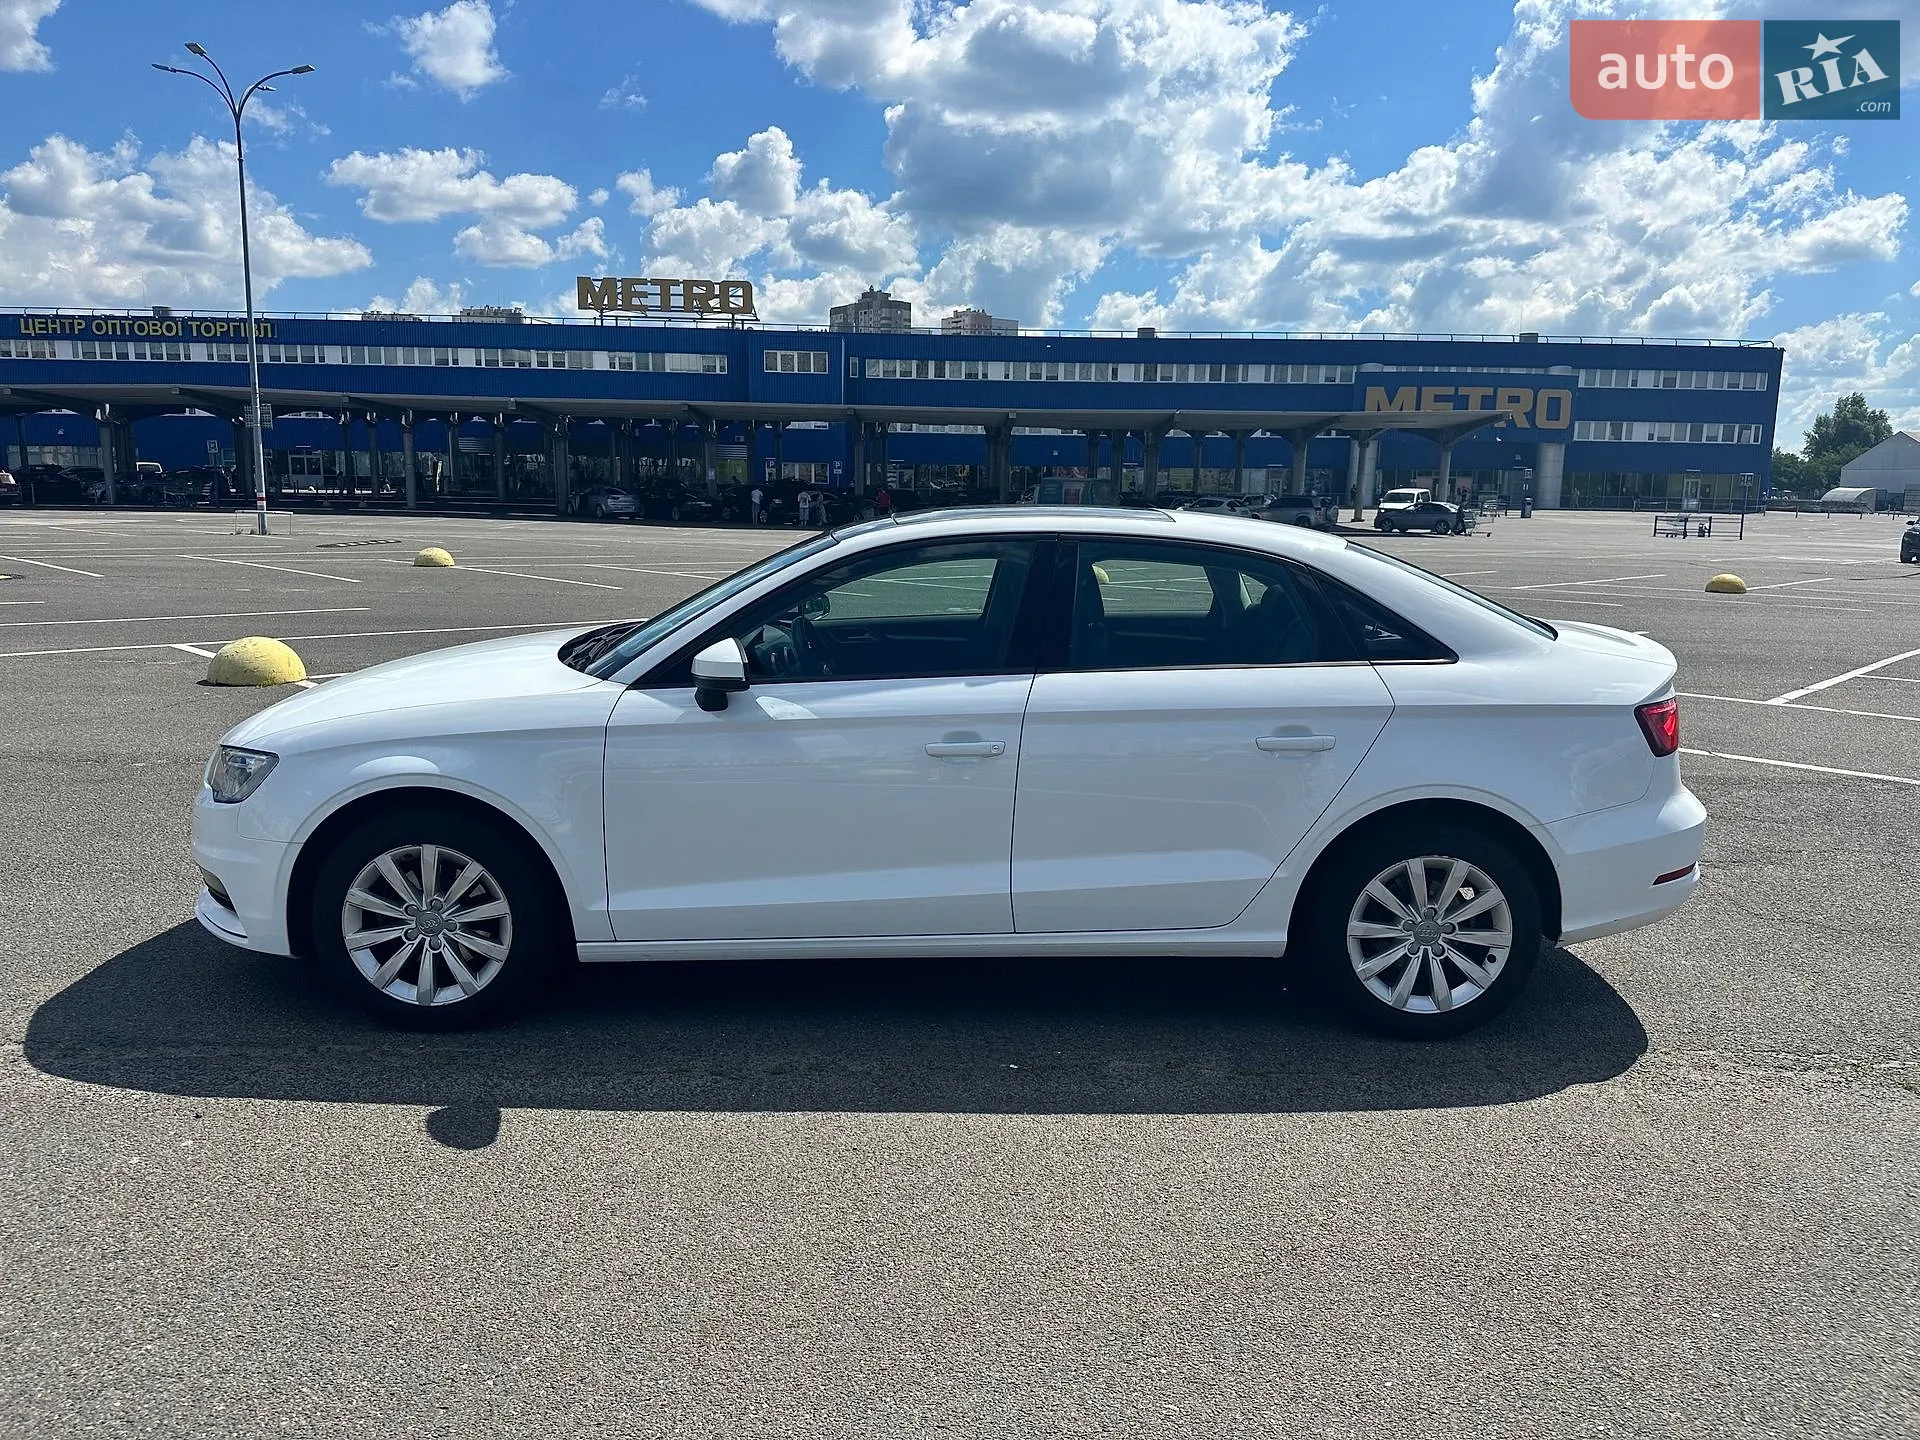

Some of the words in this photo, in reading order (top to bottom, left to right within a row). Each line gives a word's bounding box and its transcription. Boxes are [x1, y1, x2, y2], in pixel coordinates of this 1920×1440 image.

[577, 276, 753, 314] METRO
[20, 318, 86, 336] ЦЕНТР
[92, 317, 183, 337] ОПТОВОЇ
[1364, 386, 1573, 429] METRO
